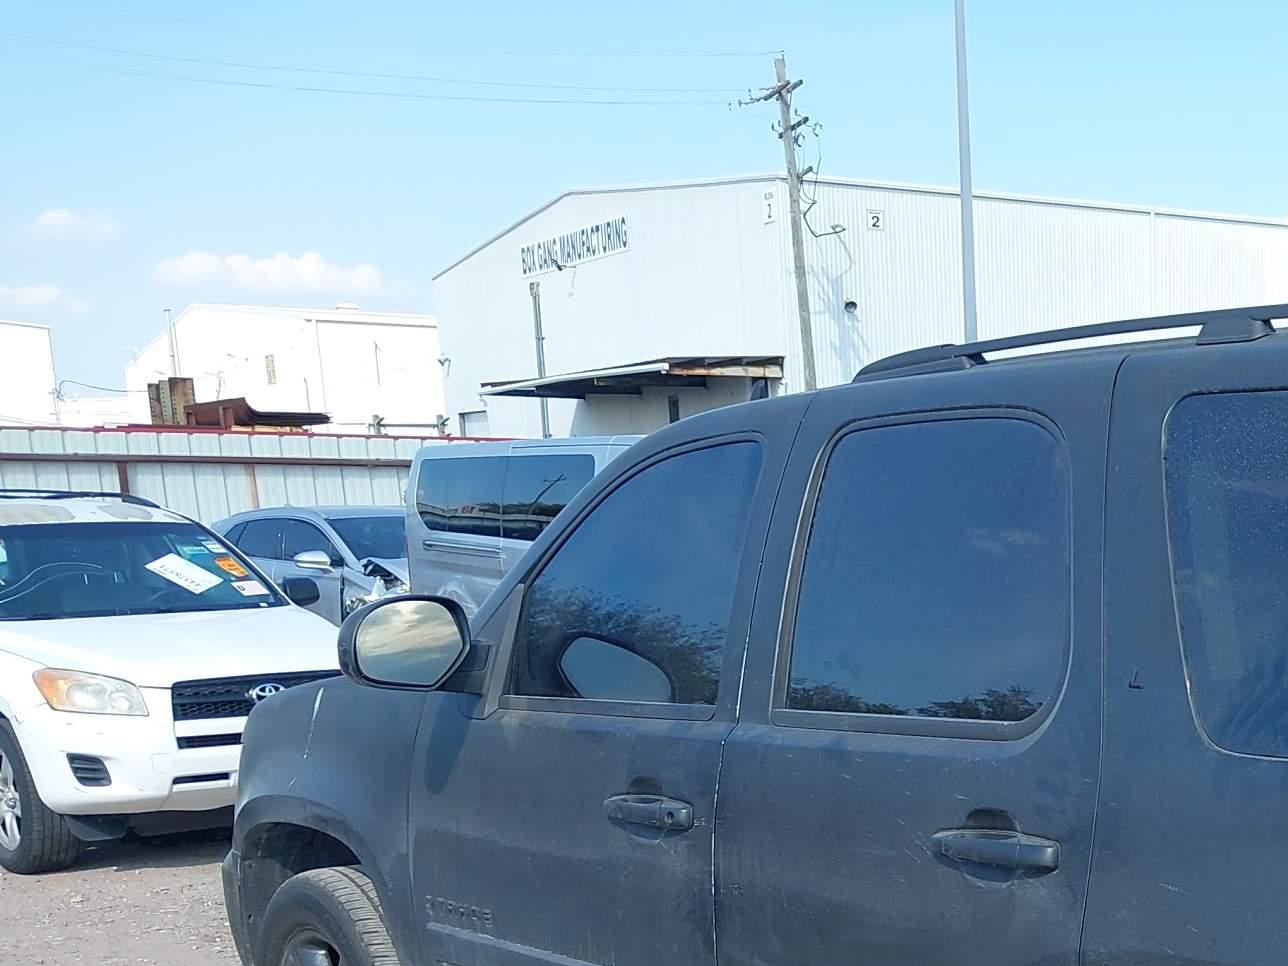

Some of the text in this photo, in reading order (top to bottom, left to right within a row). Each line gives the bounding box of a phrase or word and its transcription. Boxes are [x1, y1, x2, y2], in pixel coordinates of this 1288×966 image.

[871, 215, 881, 229] 2
[521, 216, 628, 275] BOX GANG MANUFACTURING
